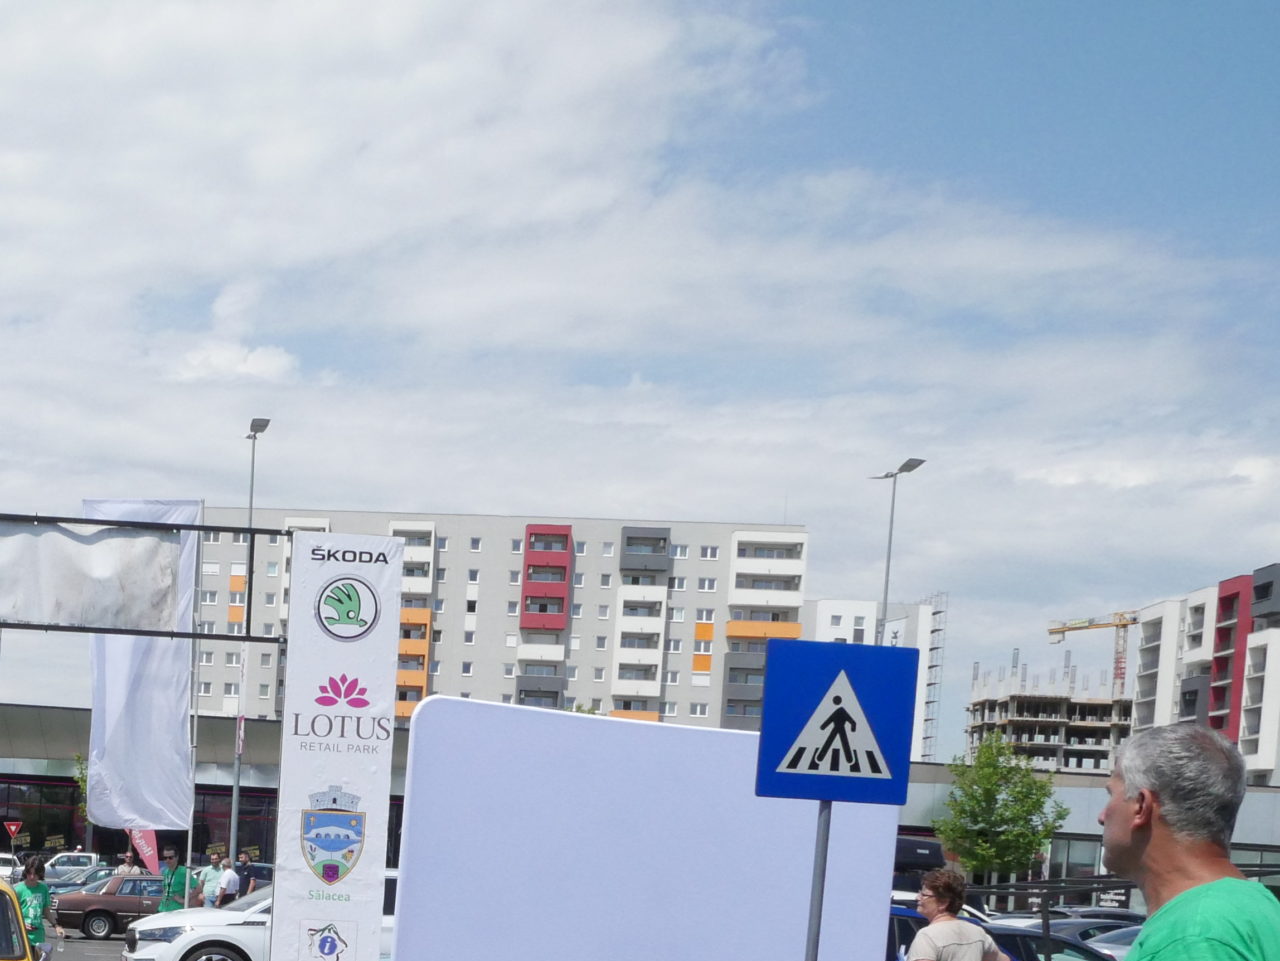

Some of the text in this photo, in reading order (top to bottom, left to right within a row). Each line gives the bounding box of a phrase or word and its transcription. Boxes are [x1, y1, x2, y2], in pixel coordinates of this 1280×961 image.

[311, 545, 389, 565] ŠKODA
[292, 713, 391, 741] LOTUS
[300, 742, 379, 754] RETAIL PARK
